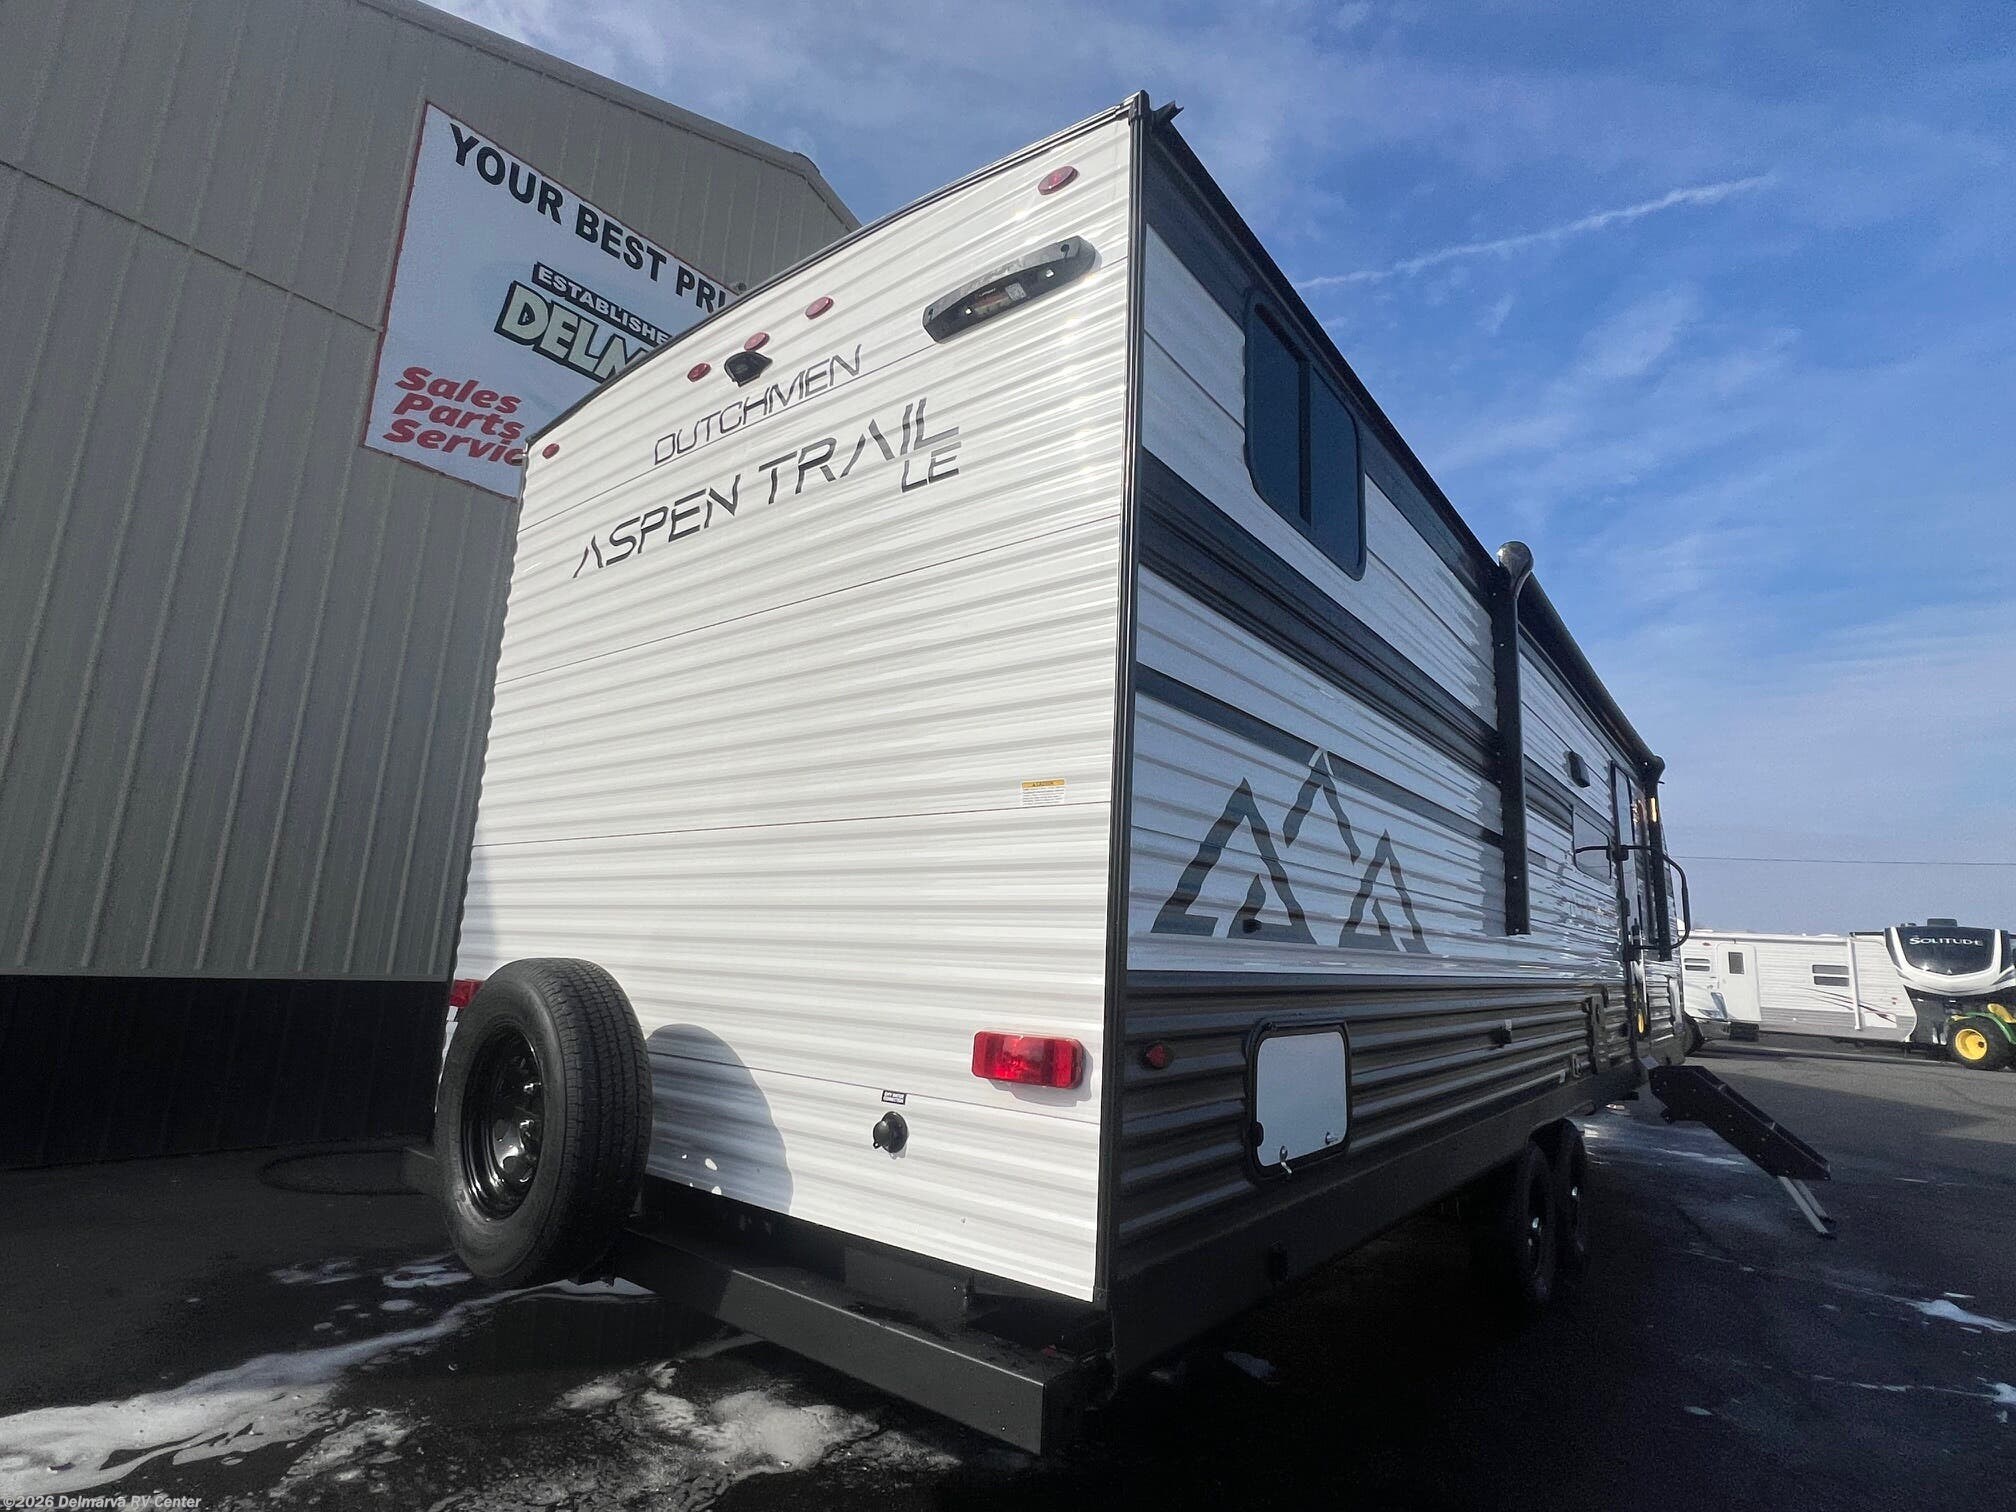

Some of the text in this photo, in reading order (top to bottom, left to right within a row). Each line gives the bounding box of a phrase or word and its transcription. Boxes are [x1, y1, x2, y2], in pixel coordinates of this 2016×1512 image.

[450, 123, 563, 225] YOUR
[576, 203, 667, 282] BEST
[395, 367, 522, 414] Sales
[654, 344, 861, 465] DUTCHMEN
[393, 393, 525, 440] Parts
[383, 419, 525, 466] Servic
[901, 441, 961, 493] LE
[573, 398, 960, 578] ASPEN TRAIL
[1909, 936, 1984, 946] SOLITUDE
